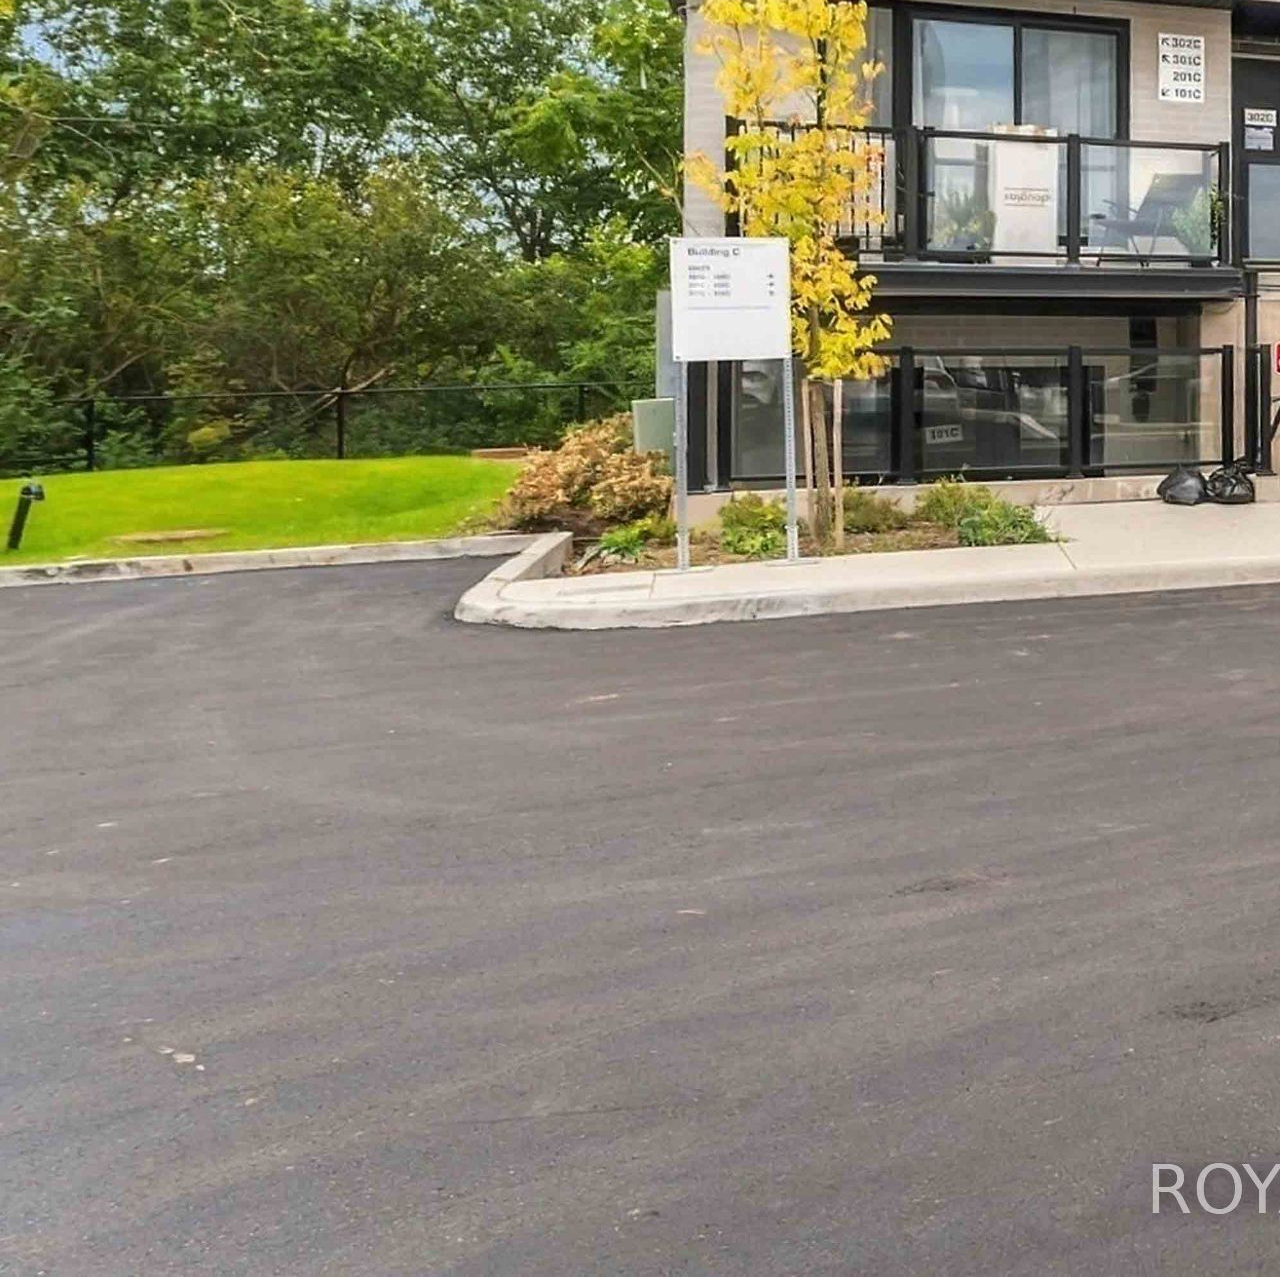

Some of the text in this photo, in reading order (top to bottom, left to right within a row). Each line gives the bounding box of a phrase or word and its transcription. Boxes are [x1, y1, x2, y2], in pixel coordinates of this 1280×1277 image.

[1172, 37, 1201, 49] 302C
[1172, 54, 1201, 66] 301C
[1173, 71, 1201, 83] 201C
[1175, 88, 1201, 99] 101C
[688, 248, 740, 257] Building C
